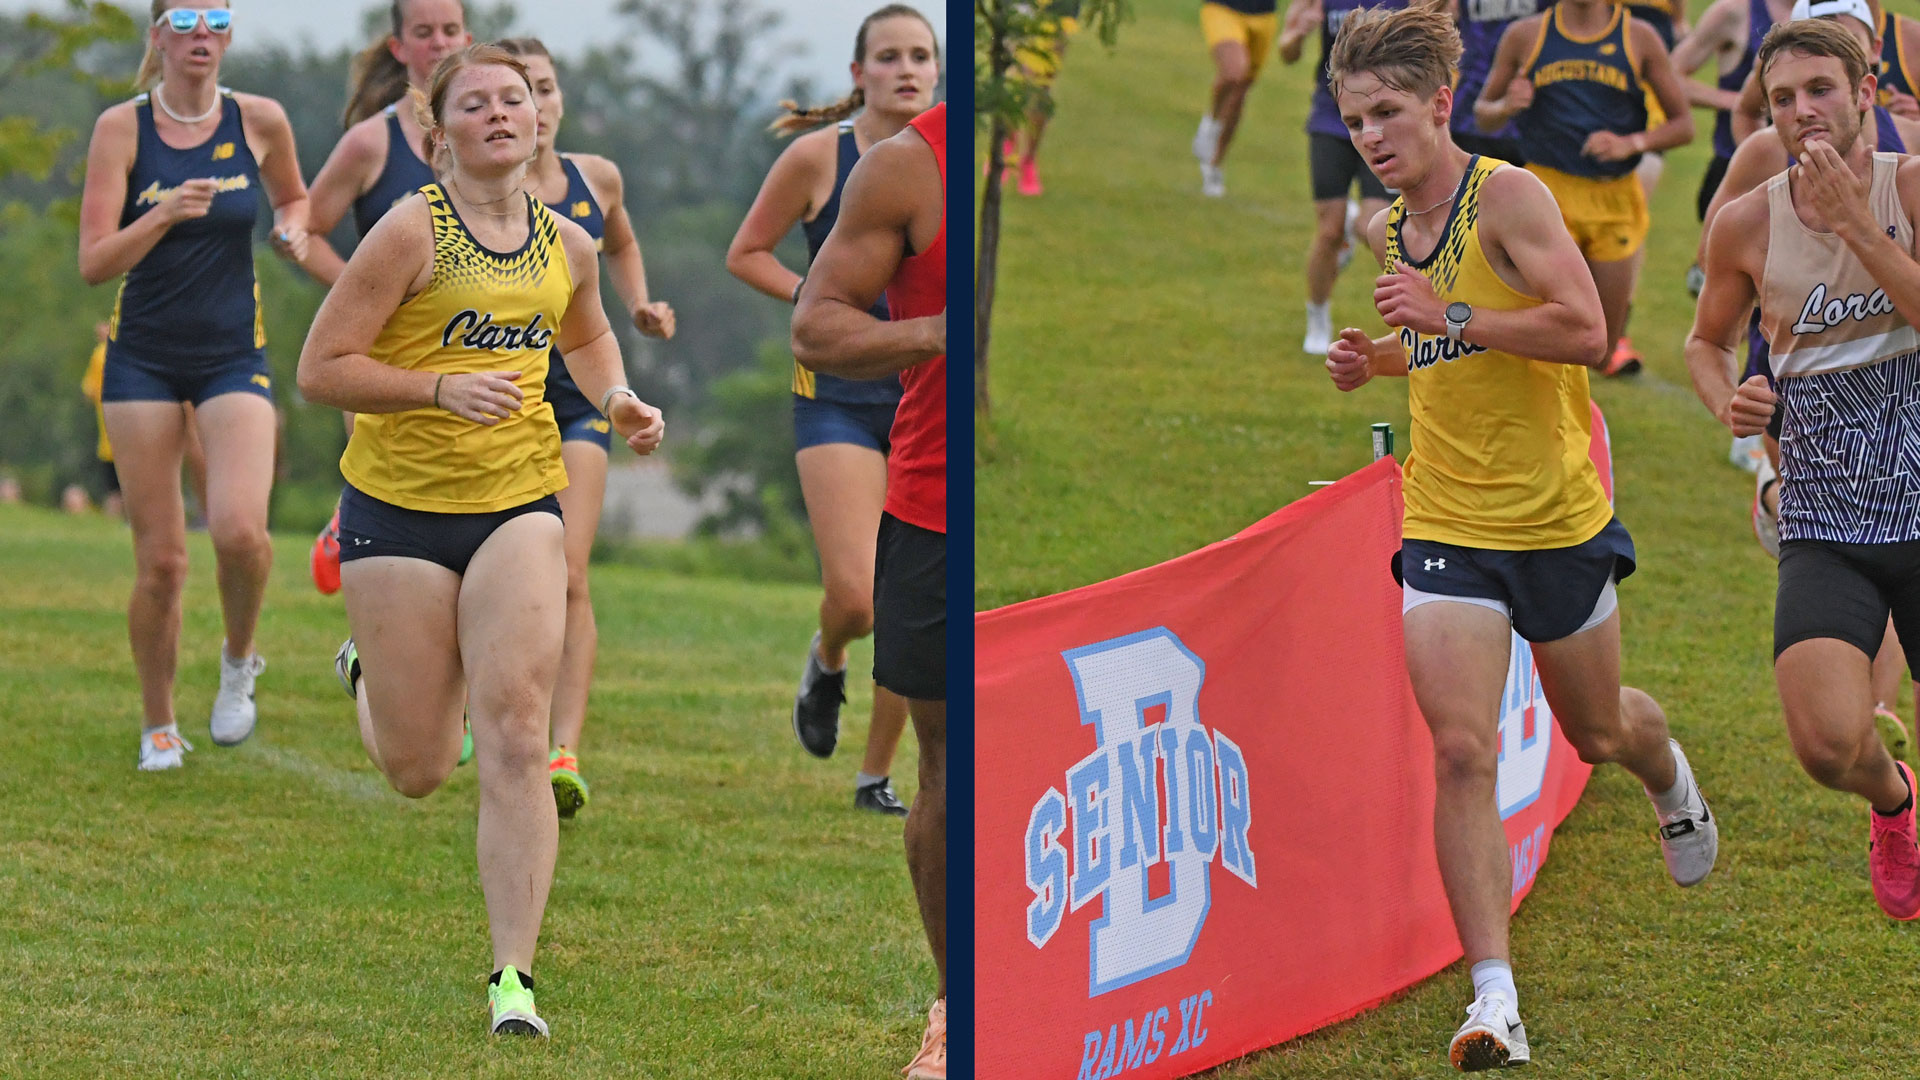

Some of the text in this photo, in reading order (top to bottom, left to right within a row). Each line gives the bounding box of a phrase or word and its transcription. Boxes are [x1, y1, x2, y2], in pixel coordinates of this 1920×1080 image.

[1534, 59, 1628, 91] AUGUSTANA
[1790, 282, 1895, 336] Lora
[1024, 721, 1258, 950] SENIOR
[1076, 988, 1214, 1080] RAMS XC
